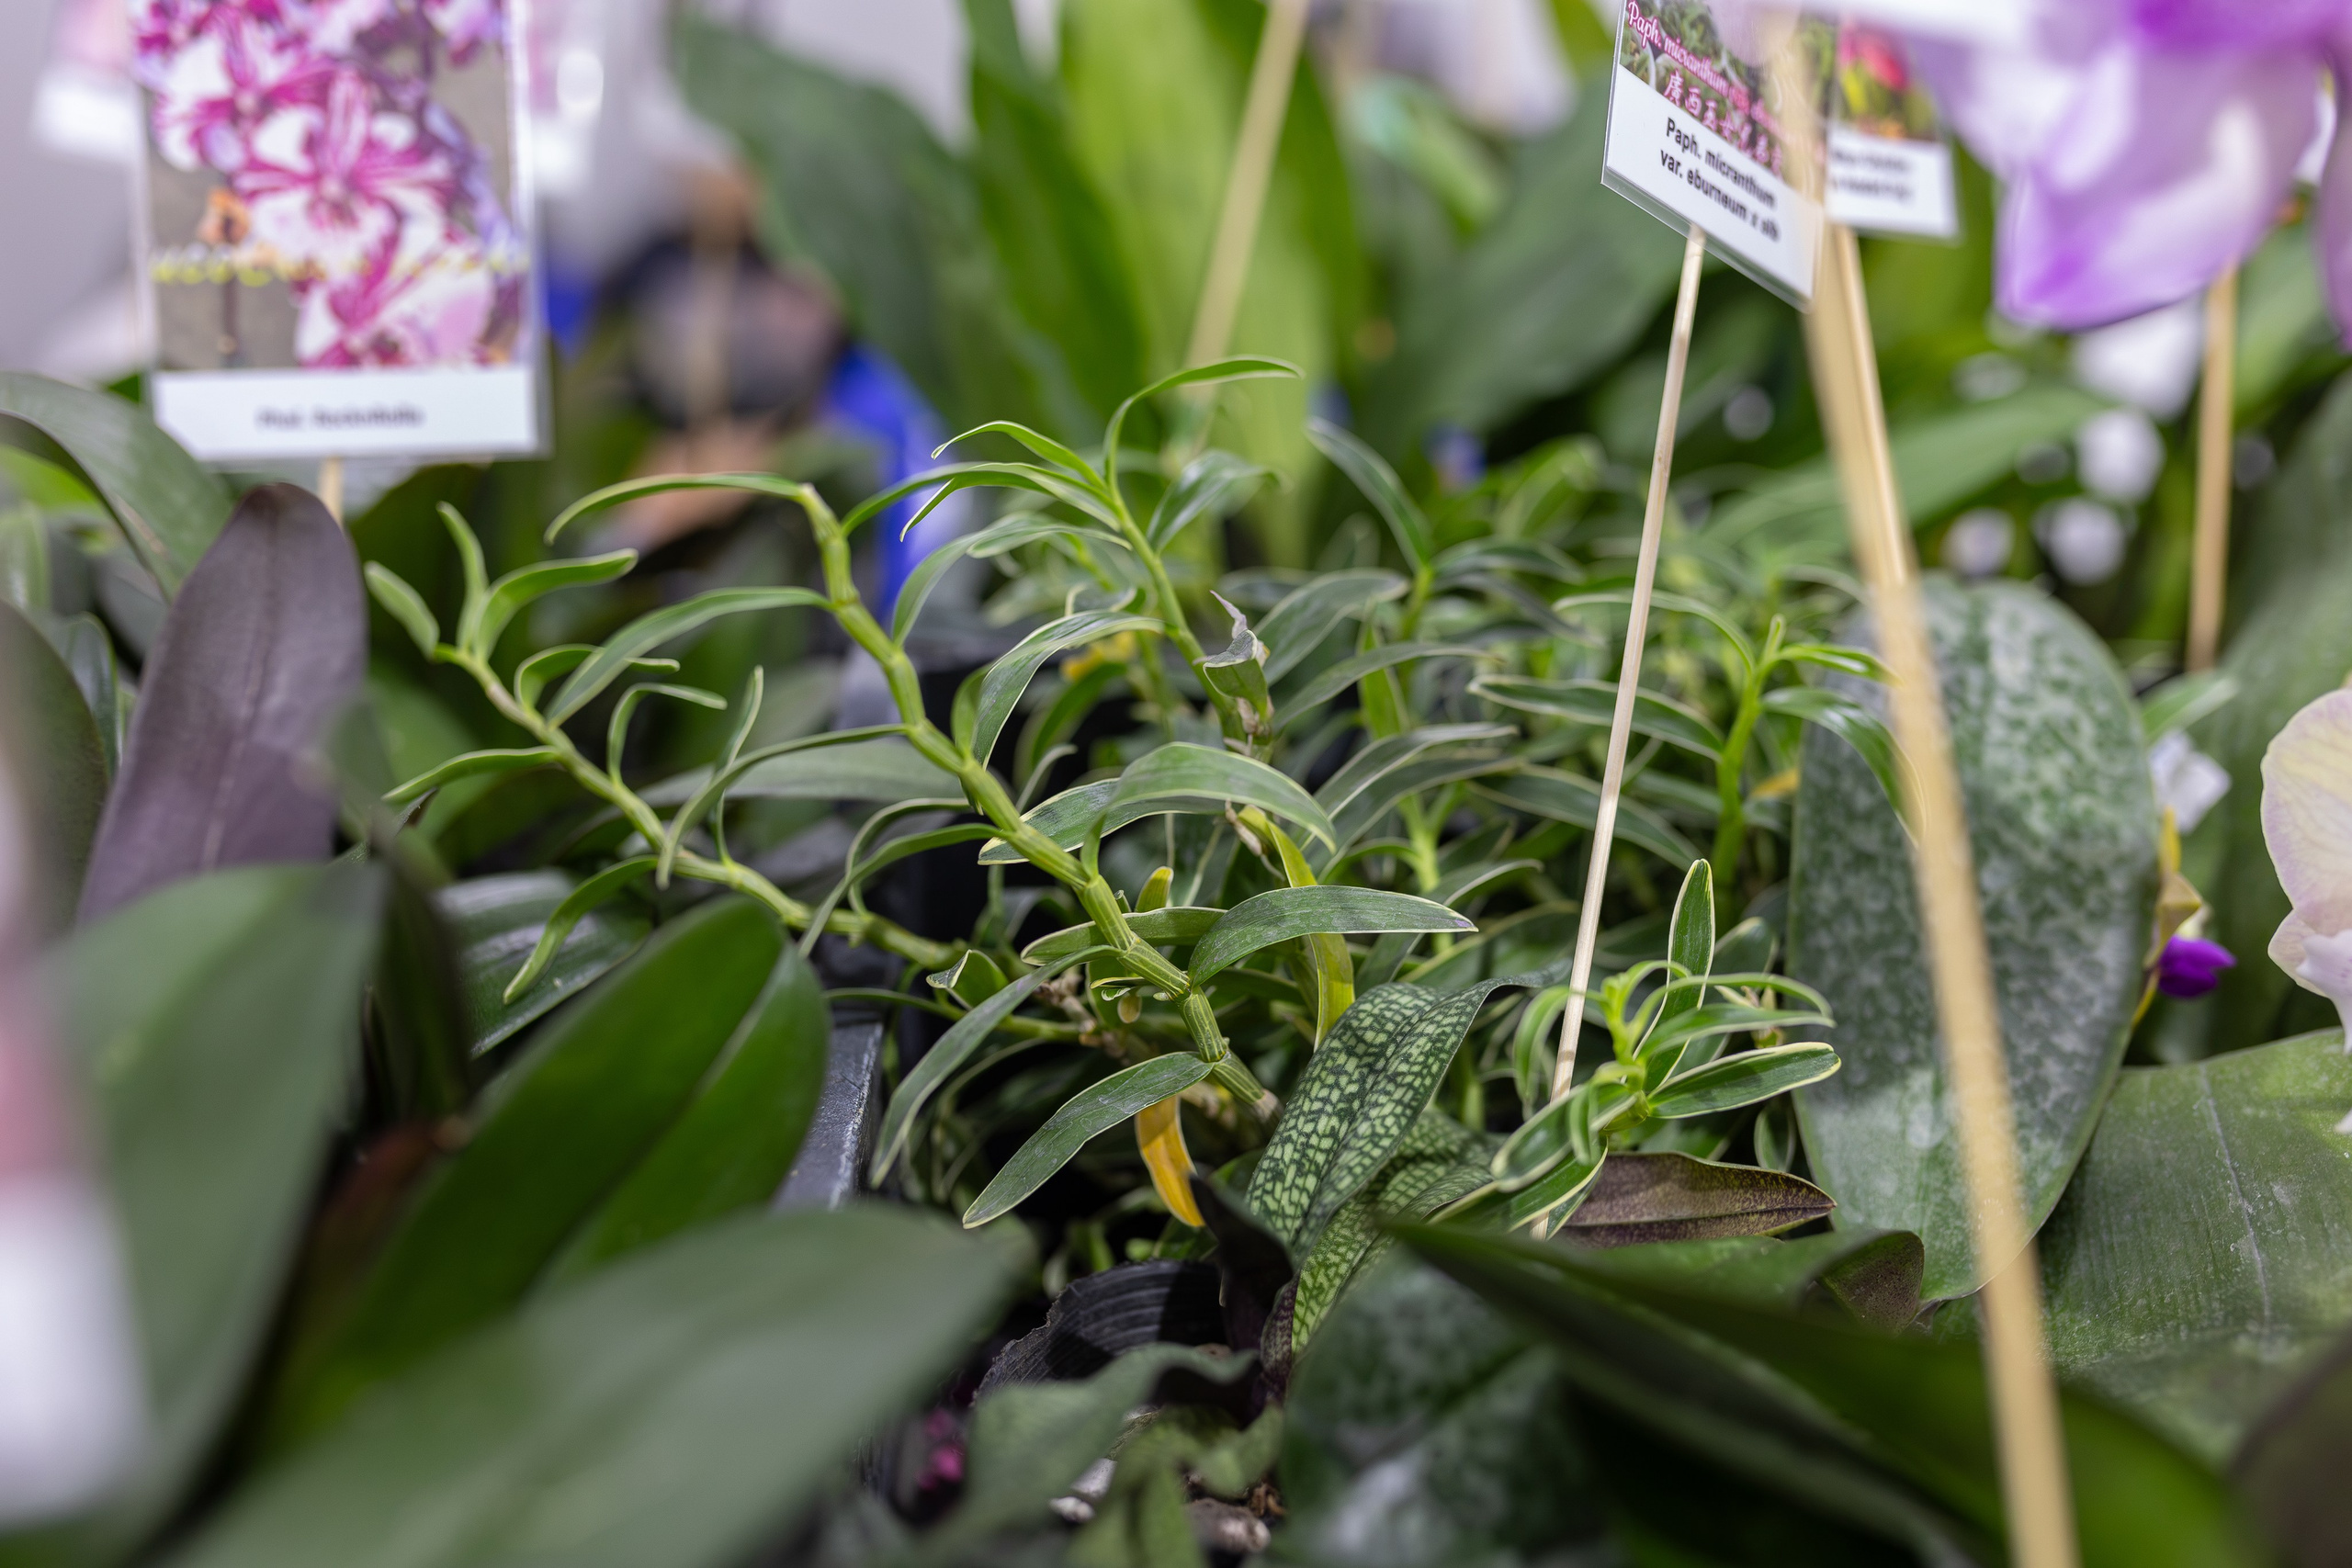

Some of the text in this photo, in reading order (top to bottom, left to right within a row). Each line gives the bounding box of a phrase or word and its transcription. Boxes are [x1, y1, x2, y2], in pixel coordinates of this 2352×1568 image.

[1628, 0, 1663, 49] Paph.
[1660, 149, 1683, 179] var.
[1687, 168, 1747, 221] eburneum
[1666, 117, 1702, 160] Paph.
[1704, 149, 1777, 210] micranthum
